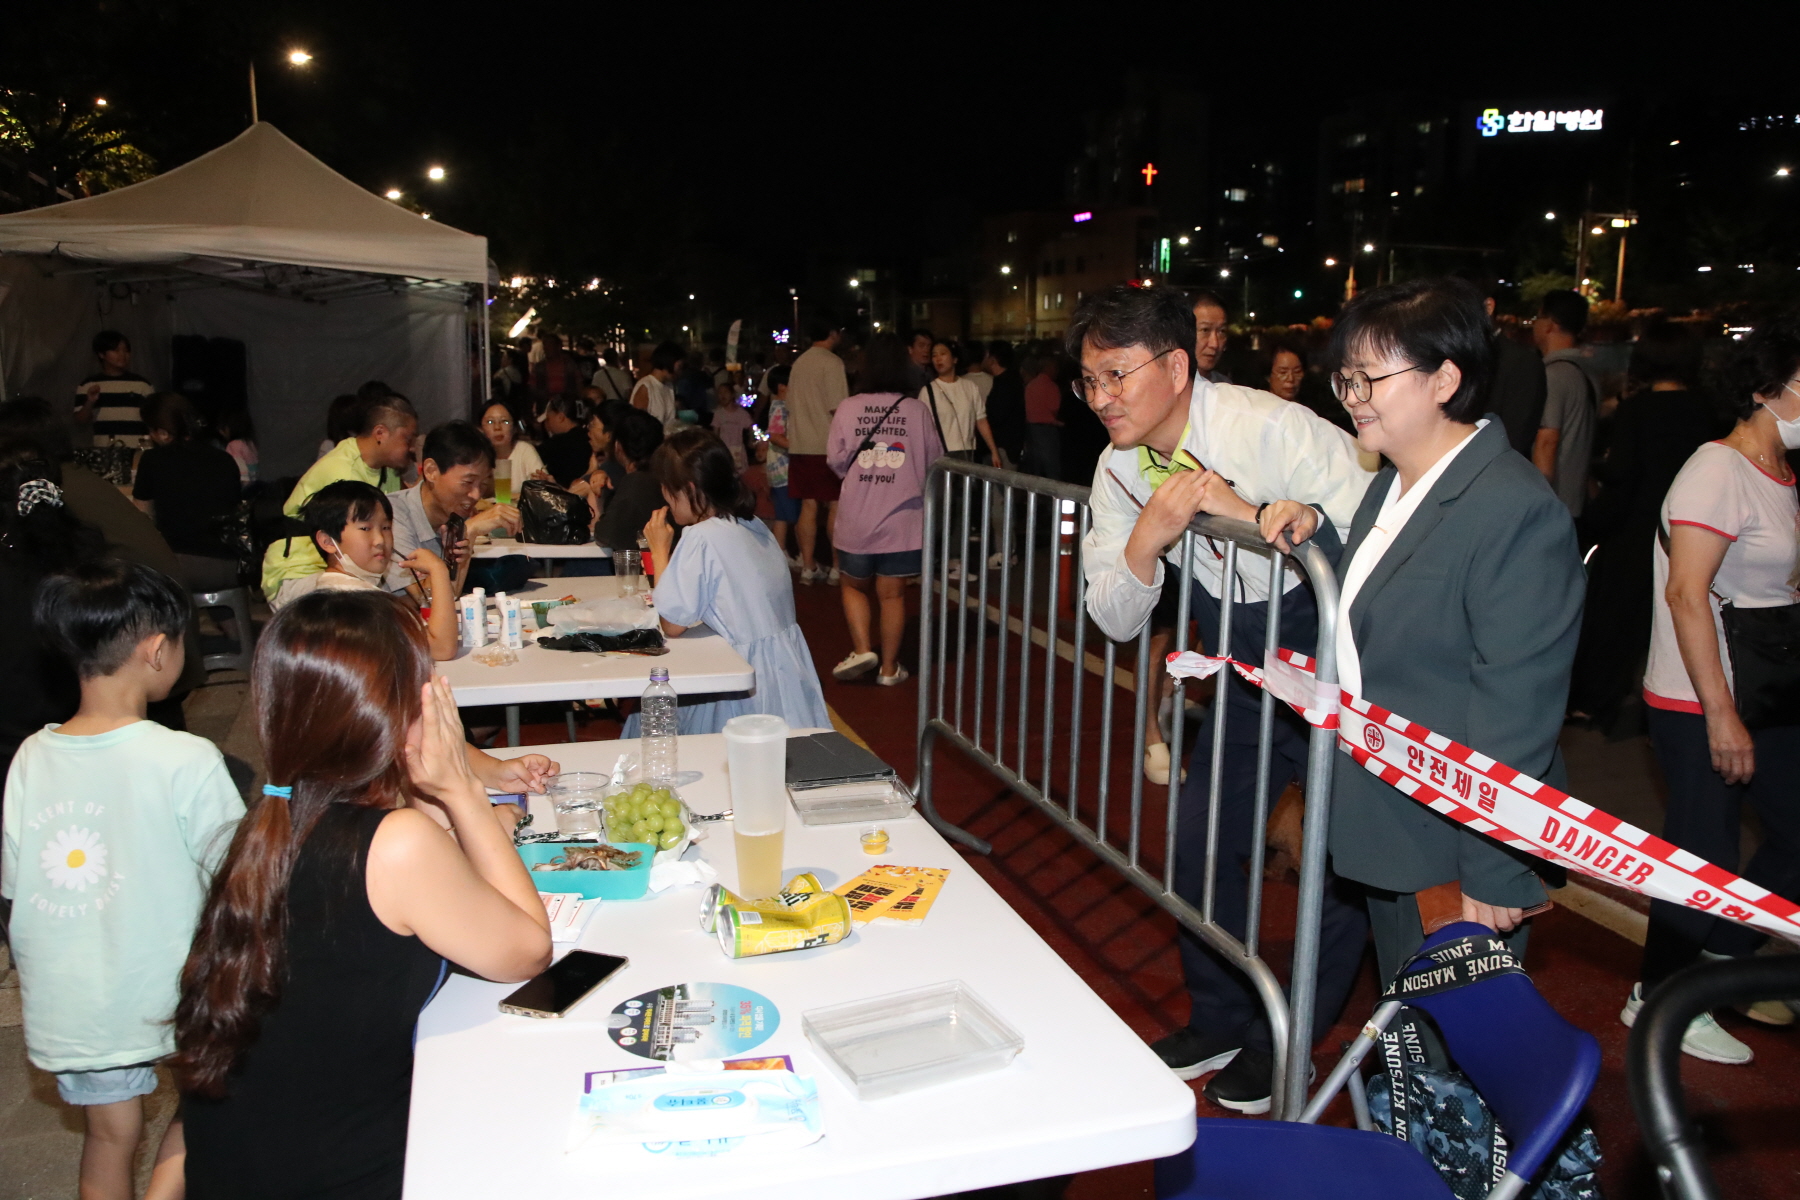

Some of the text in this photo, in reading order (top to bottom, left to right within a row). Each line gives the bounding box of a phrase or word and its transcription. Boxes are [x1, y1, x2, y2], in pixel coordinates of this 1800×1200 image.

[1507, 109, 1603, 133] 한일병원
[864, 405, 900, 414] MAKS
[887, 416, 907, 425] LIFE
[855, 427, 909, 437] DELGHTED.
[859, 473, 896, 485] see you!
[1406, 744, 1499, 814] 안전제일
[27, 800, 105, 831] SCENT OF
[1539, 815, 1655, 885] DANGER
[29, 871, 126, 918] LOVELY DAISY
[1403, 965, 1457, 993] MAISON
[739, 1000, 753, 1015] 35%
[738, 1026, 753, 1038] 할인
[1378, 1031, 1406, 1111] KITSUNÉ
